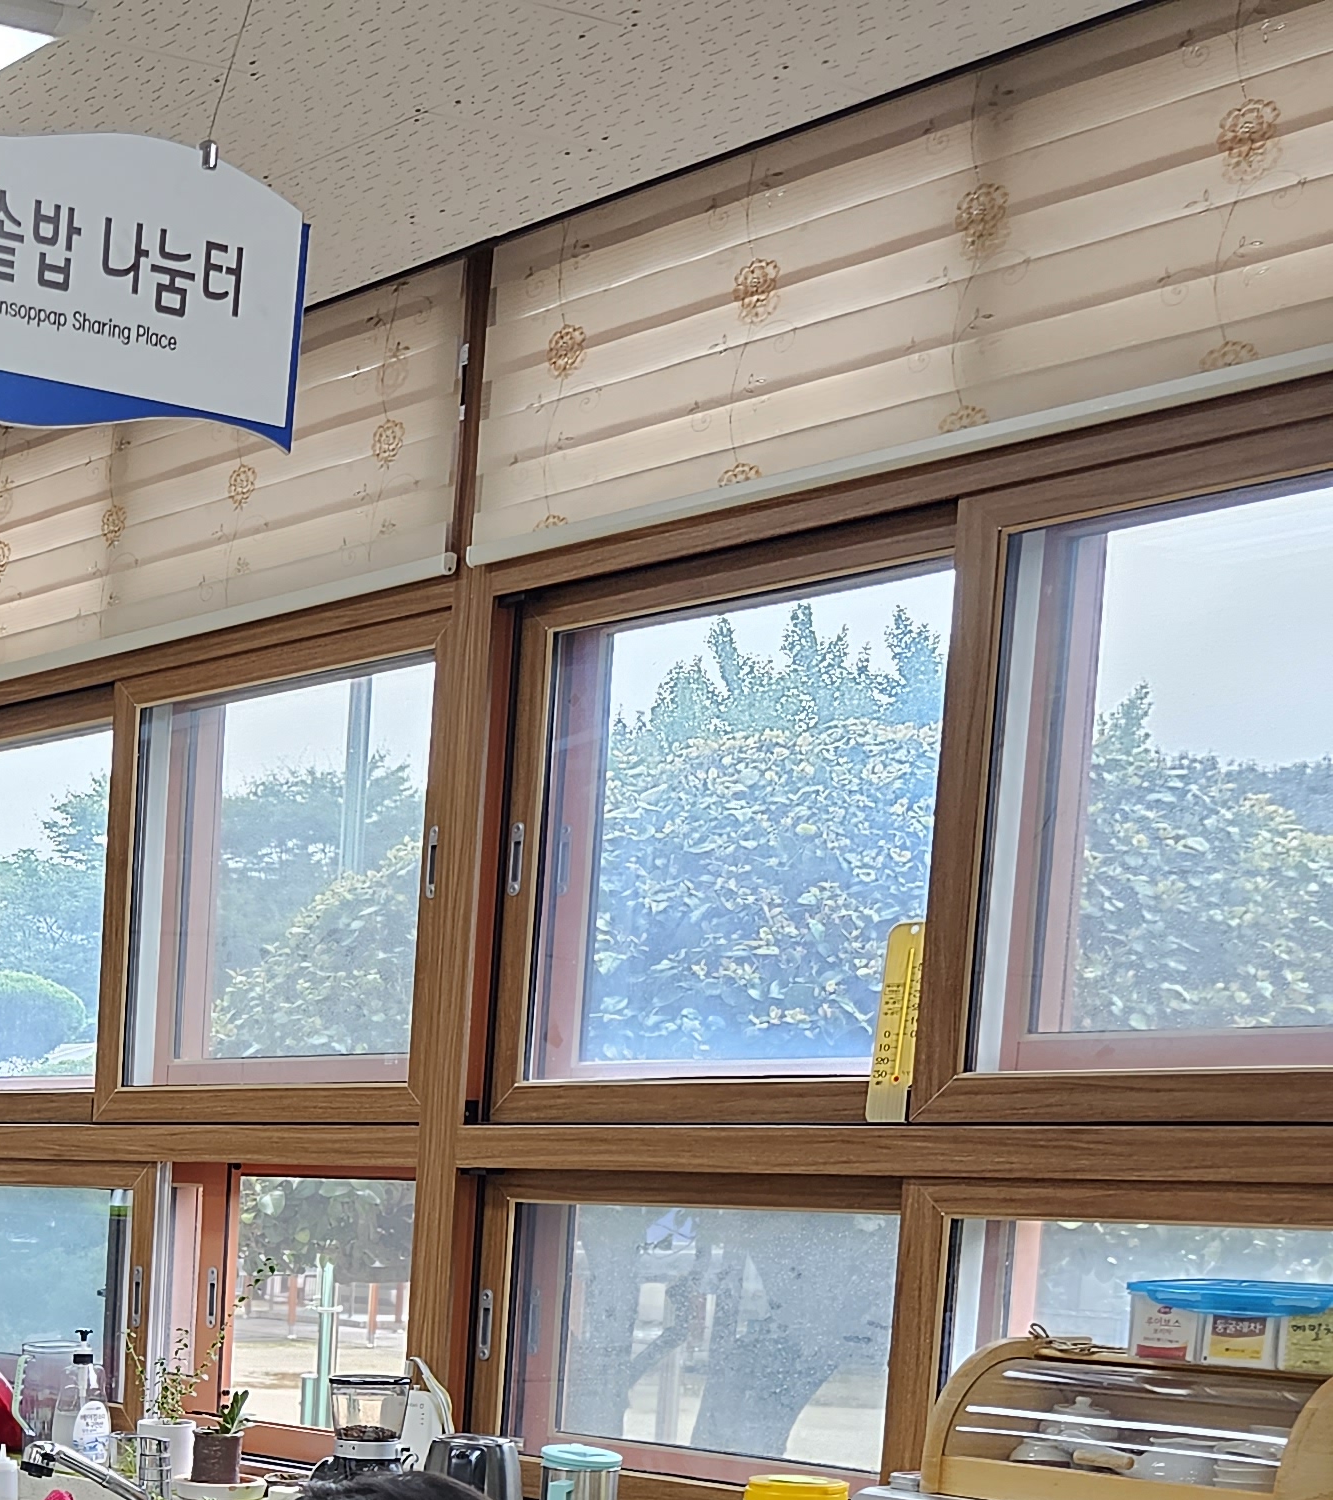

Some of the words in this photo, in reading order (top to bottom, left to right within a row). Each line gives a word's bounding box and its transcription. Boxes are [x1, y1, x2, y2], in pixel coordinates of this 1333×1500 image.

[101, 216, 245, 318] 나눔터
[72, 310, 131, 345] Sharing
[135, 325, 178, 351] Place
[878, 1043, 891, 1052] 10
[875, 1056, 890, 1065] 20
[873, 1069, 888, 1079] 30
[1215, 1319, 1264, 1334] 둥굴레차
